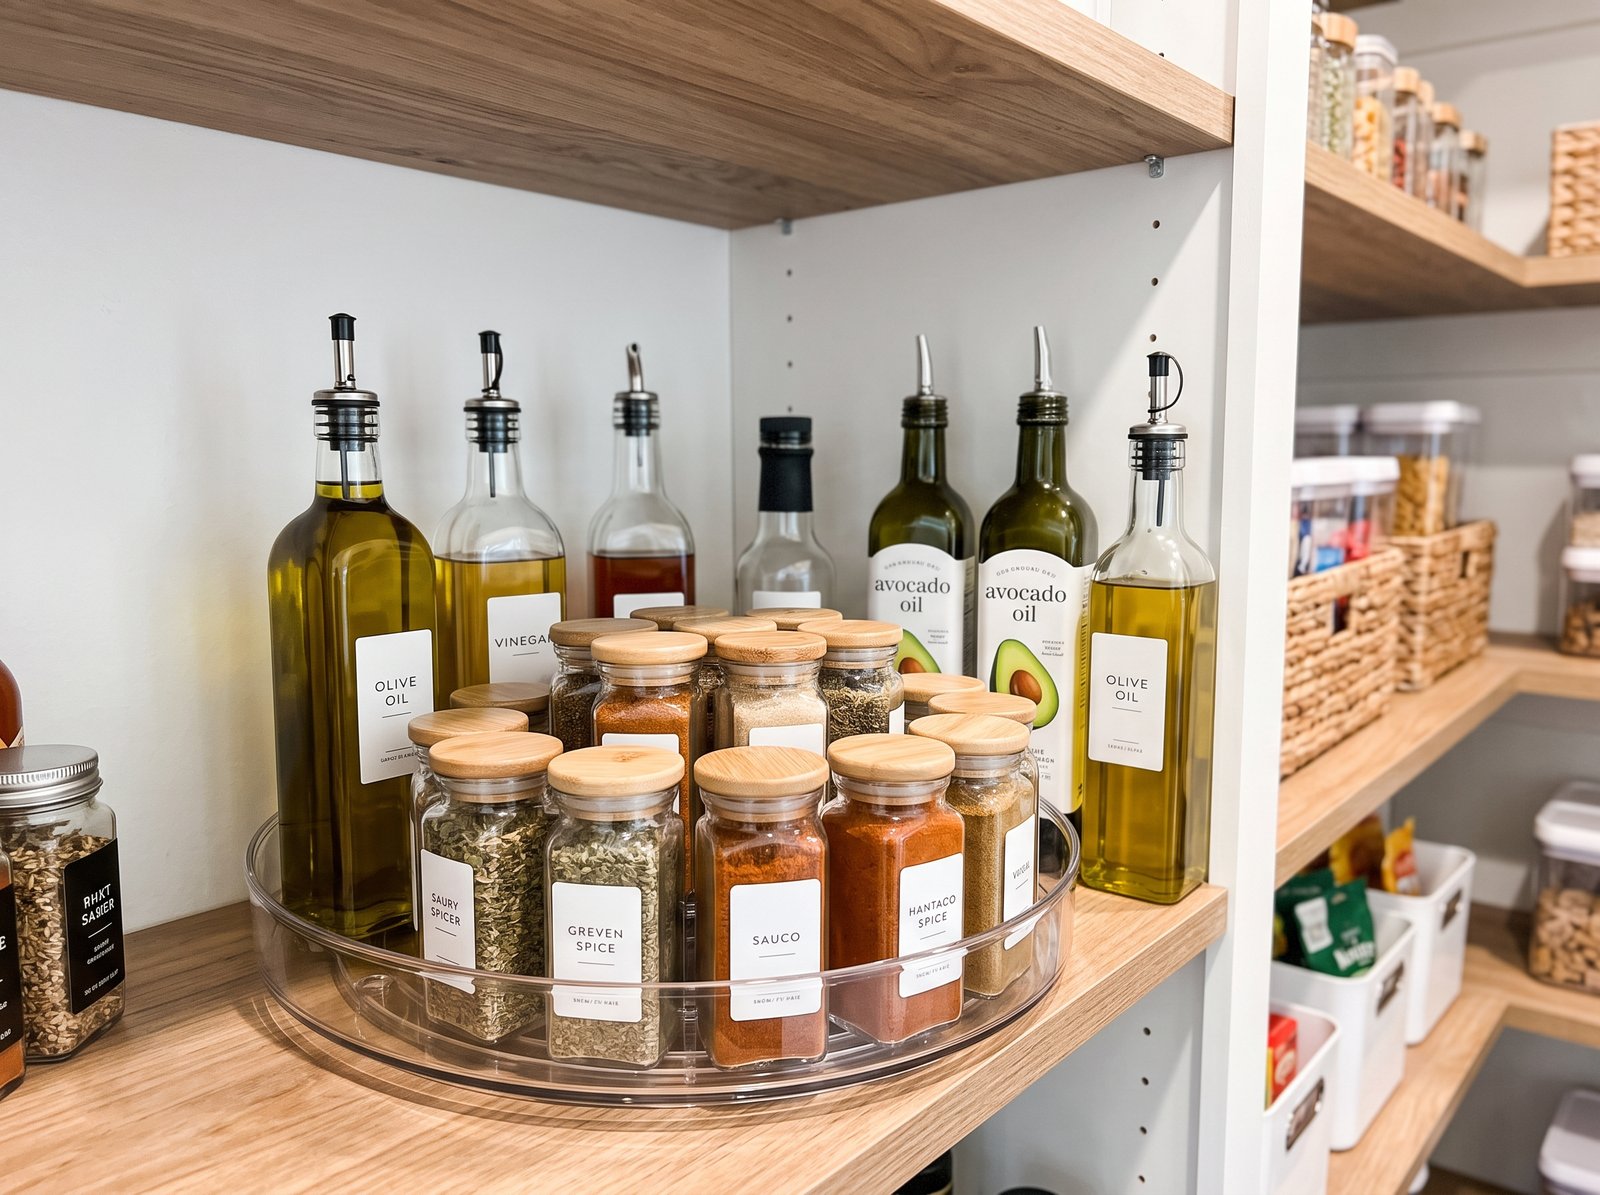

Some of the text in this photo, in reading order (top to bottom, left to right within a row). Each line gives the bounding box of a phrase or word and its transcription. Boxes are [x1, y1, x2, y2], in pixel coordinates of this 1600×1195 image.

[875, 577, 951, 594] avocado
[985, 585, 1067, 603] avocado
[900, 596, 923, 613] oil
[1012, 605, 1036, 623] oil
[375, 676, 417, 692] OLIVE
[1106, 675, 1148, 690] OLIVE
[385, 693, 409, 706] OIL
[1115, 690, 1139, 703] OIL
[431, 893, 459, 911] SAURY
[909, 894, 957, 917] HANTACO
[430, 907, 461, 926] SPICER
[918, 911, 948, 929] SPICE
[568, 926, 623, 939] GREVEN
[752, 932, 800, 946] SAUCO
[576, 942, 616, 954] SPICE
